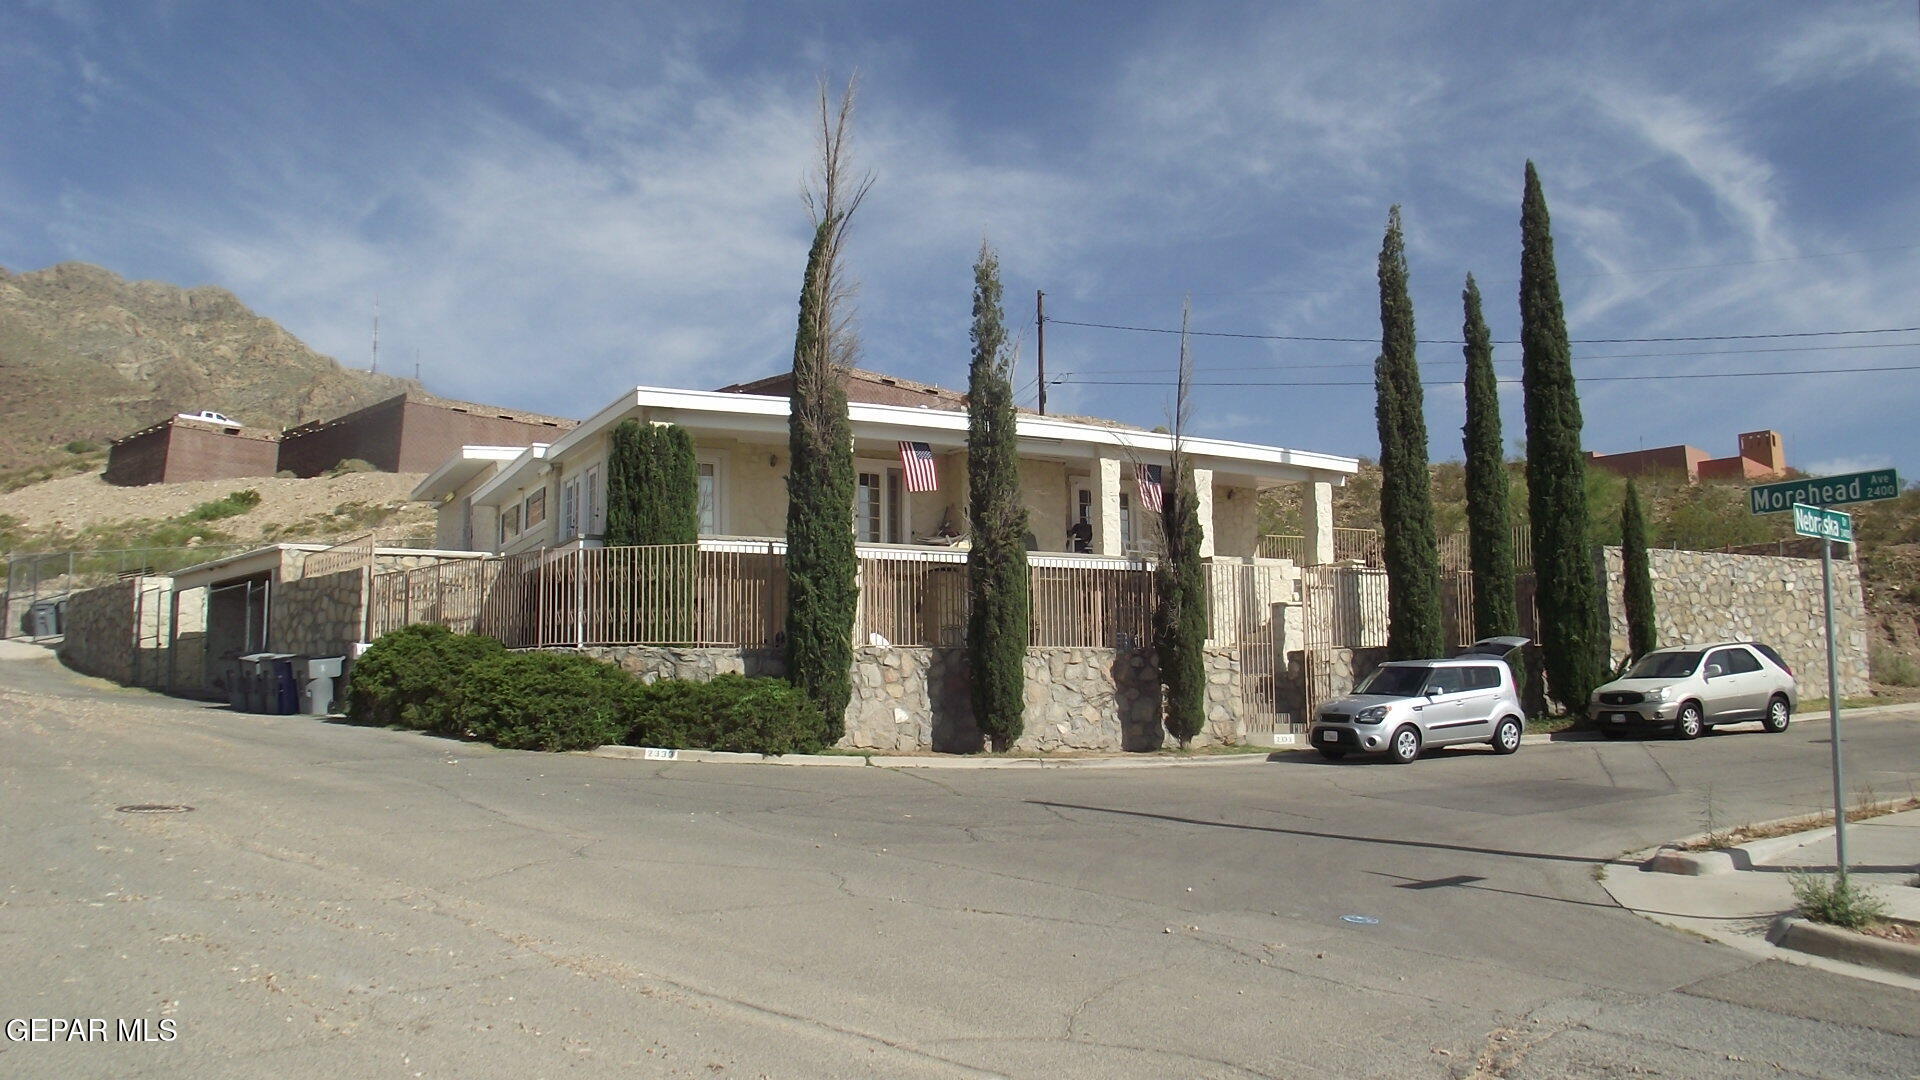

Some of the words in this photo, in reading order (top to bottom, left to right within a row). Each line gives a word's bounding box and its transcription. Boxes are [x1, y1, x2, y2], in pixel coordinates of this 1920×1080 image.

[1871, 475, 1889, 485] Ave
[1753, 477, 1860, 511] Morehead
[1866, 485, 1895, 498] 2400
[1795, 507, 1839, 537] Nebraska
